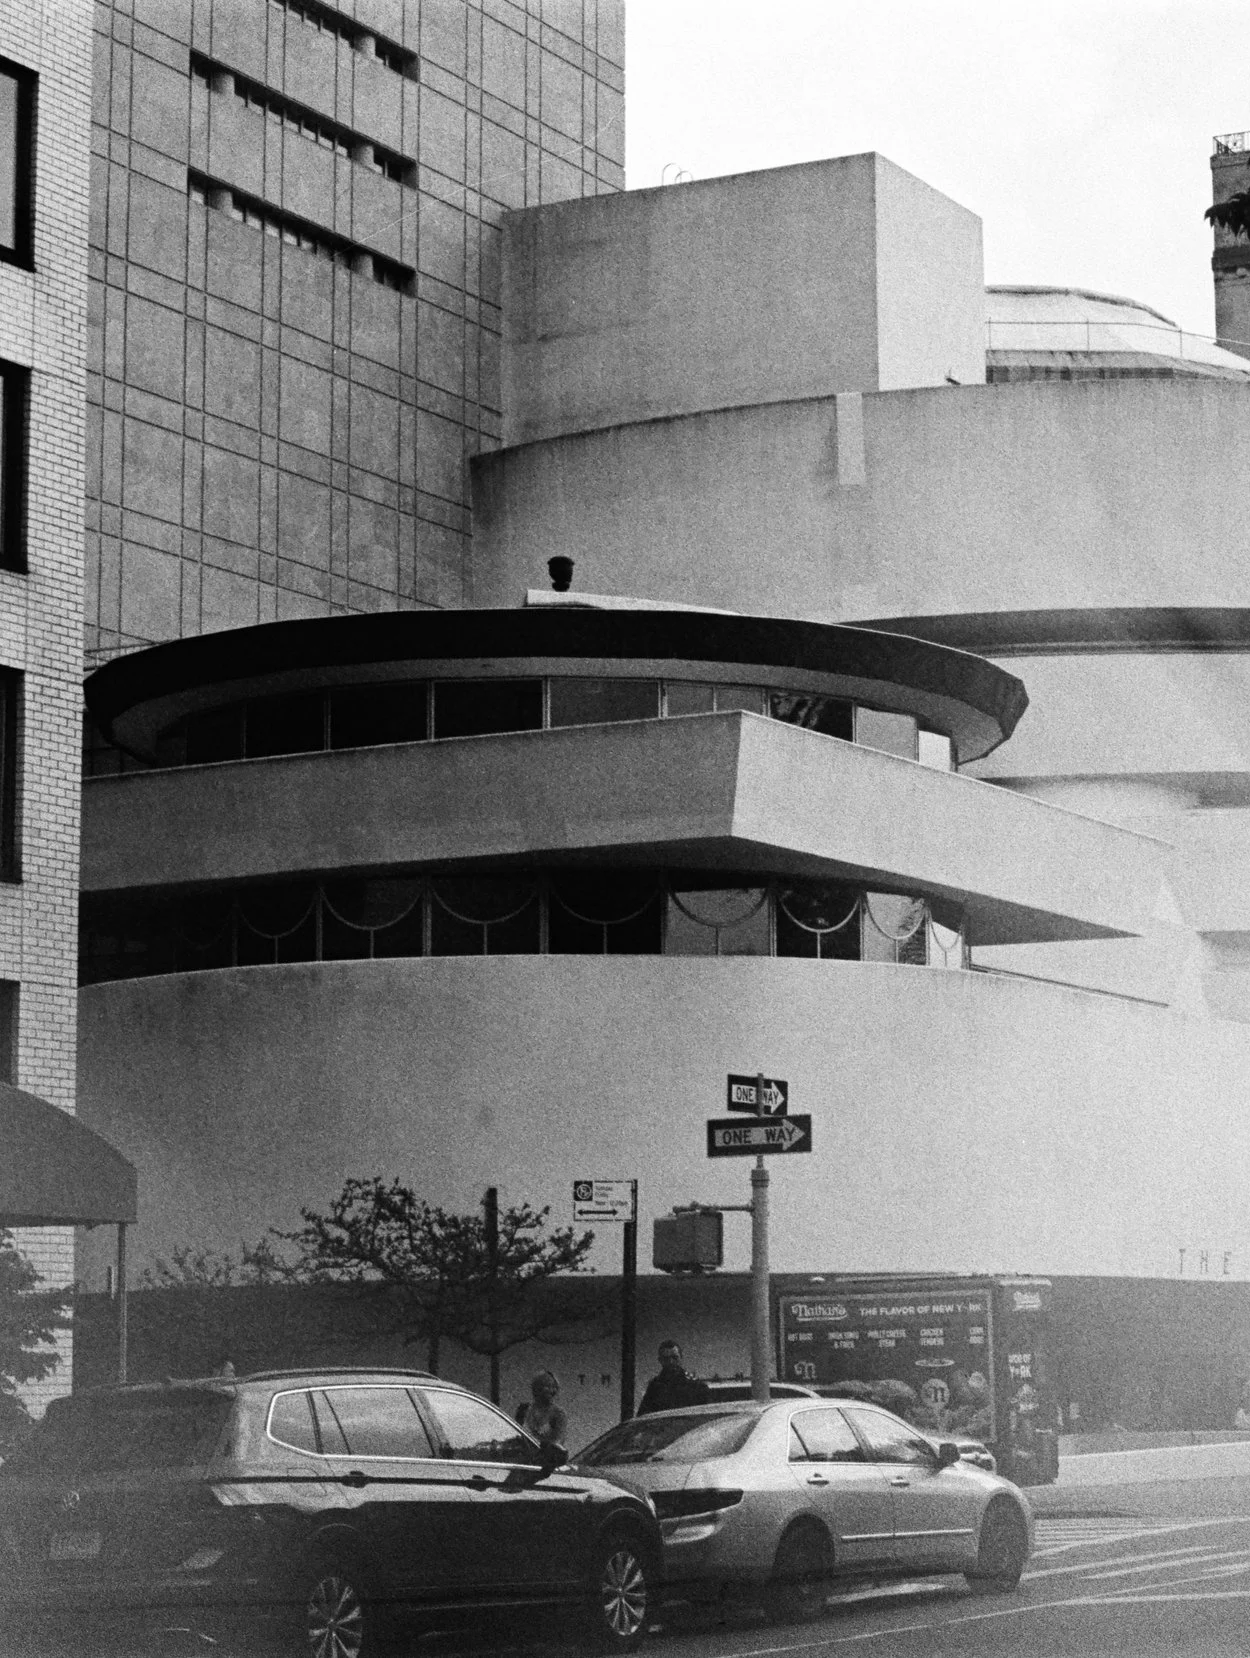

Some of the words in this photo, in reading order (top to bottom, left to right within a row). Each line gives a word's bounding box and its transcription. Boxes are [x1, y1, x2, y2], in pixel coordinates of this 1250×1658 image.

[735, 1086, 754, 1103] ONE
[722, 1129, 753, 1146] ONE
[765, 1127, 796, 1143] WAY
[1178, 1247, 1233, 1276] THE
[791, 1303, 848, 1321] Nathan's
[860, 1307, 878, 1317] THE
[880, 1306, 916, 1316] FLAVOR
[917, 1305, 931, 1314] OF
[932, 1303, 955, 1314] NEW
[956, 1301, 982, 1313] YRK
